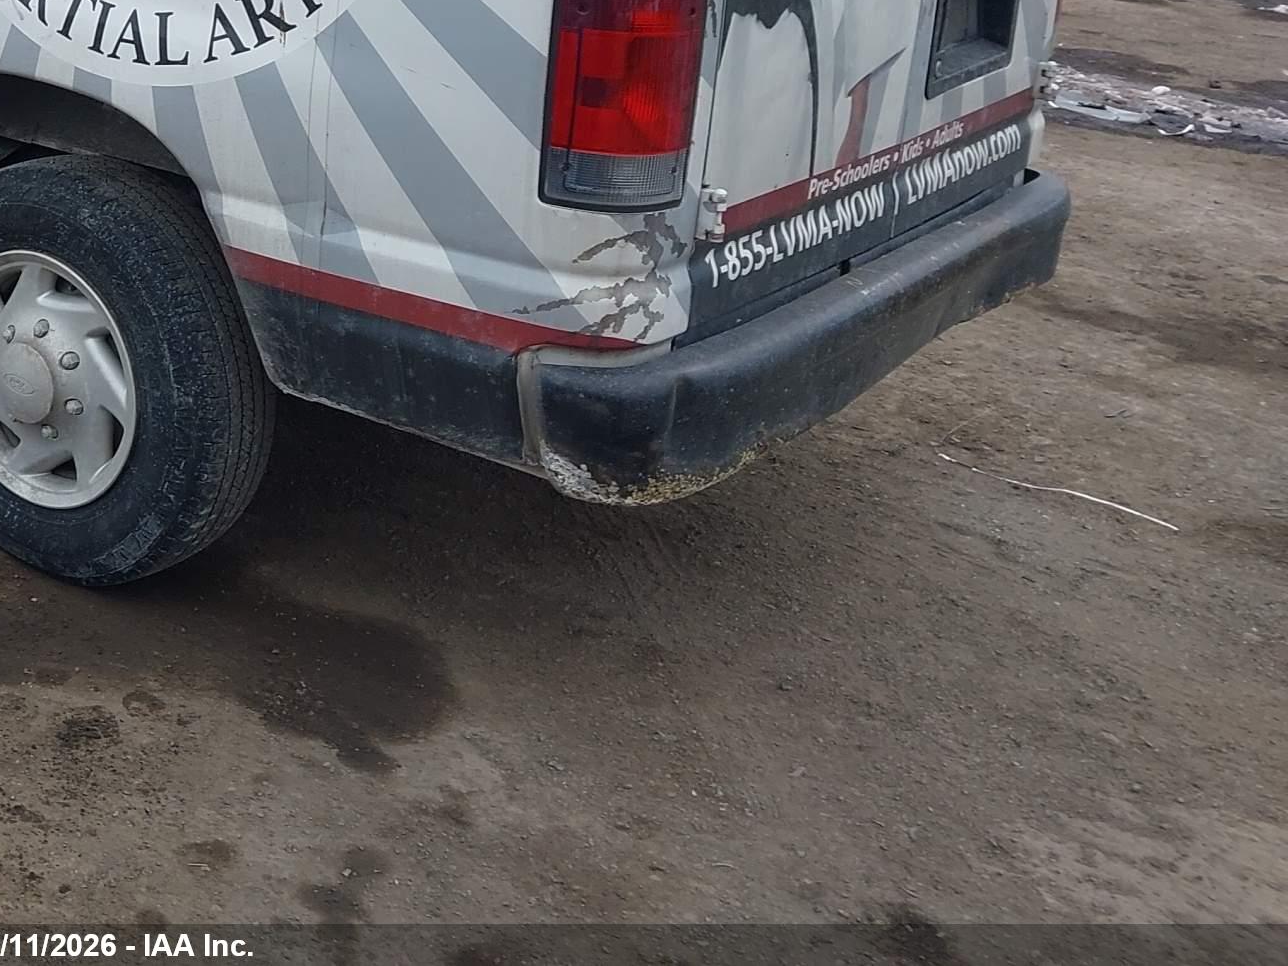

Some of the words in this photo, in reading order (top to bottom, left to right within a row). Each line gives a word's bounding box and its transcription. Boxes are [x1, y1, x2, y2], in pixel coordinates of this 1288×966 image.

[703, 180, 886, 289] 1-855-LVMA-NOW
[906, 123, 1022, 205] LVMAnow.com
[807, 153, 891, 201] Pre-Schoolers
[901, 137, 924, 164] Kids
[931, 119, 965, 150] Adults
